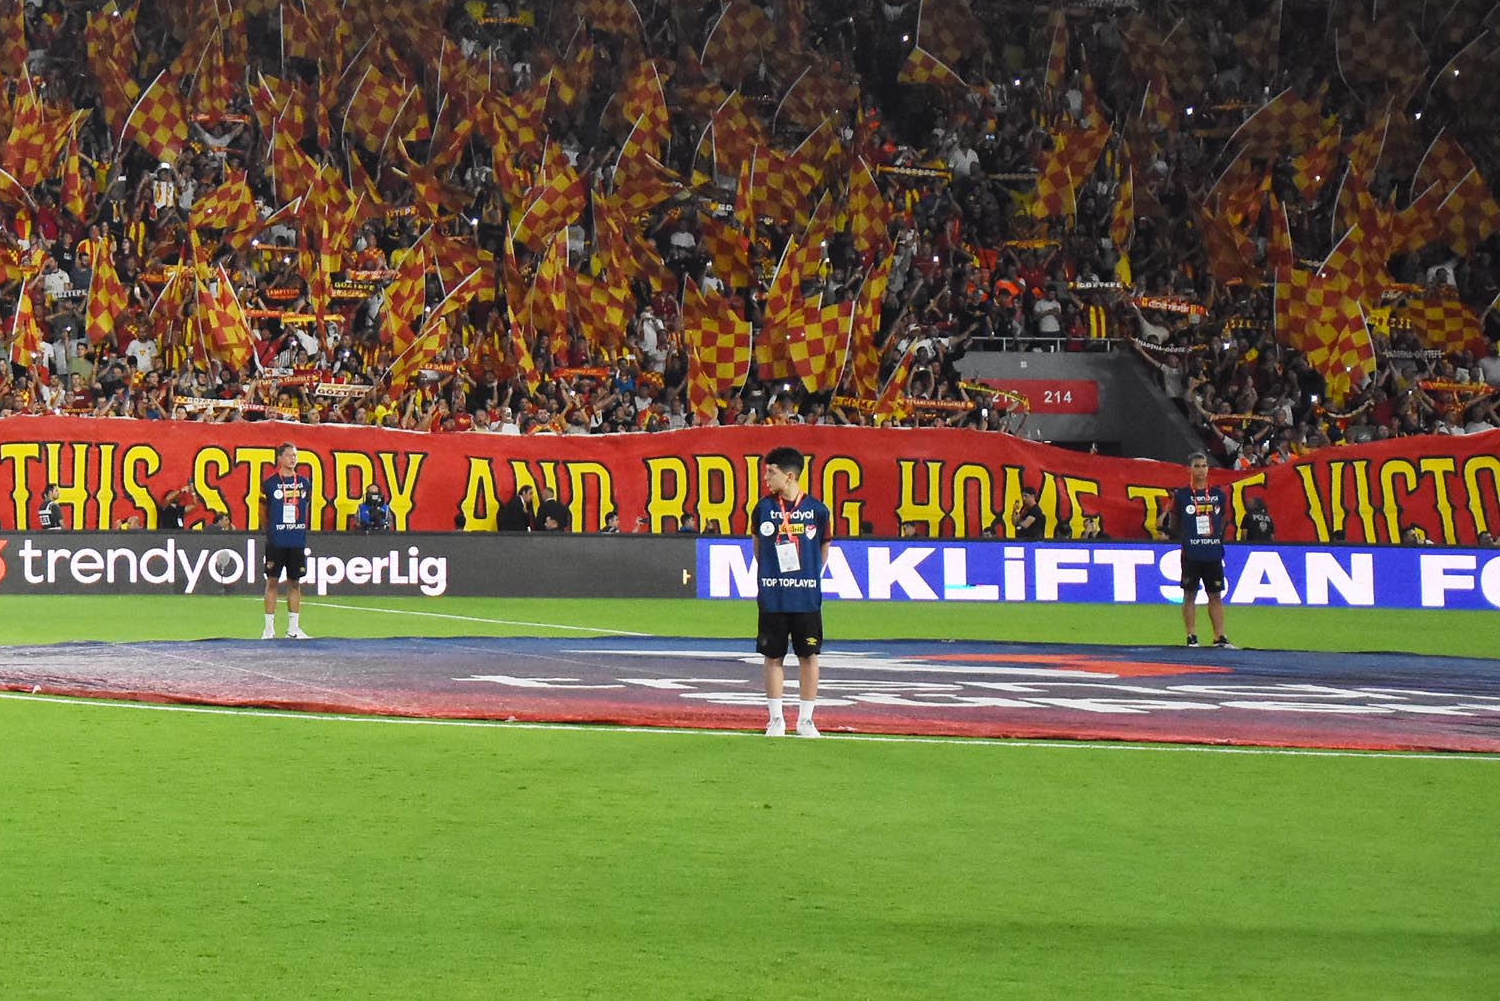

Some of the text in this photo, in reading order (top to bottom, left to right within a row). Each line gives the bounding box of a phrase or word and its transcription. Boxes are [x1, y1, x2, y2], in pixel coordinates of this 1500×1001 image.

[1043, 390, 1073, 404] 214
[0, 441, 161, 531] THIS
[460, 455, 614, 533] AND
[896, 458, 1100, 539] HOME
[1127, 472, 1267, 541] TE
[769, 509, 815, 520] trendyol
[19, 538, 448, 597] trendyol perLig
[761, 578, 778, 587] TOP
